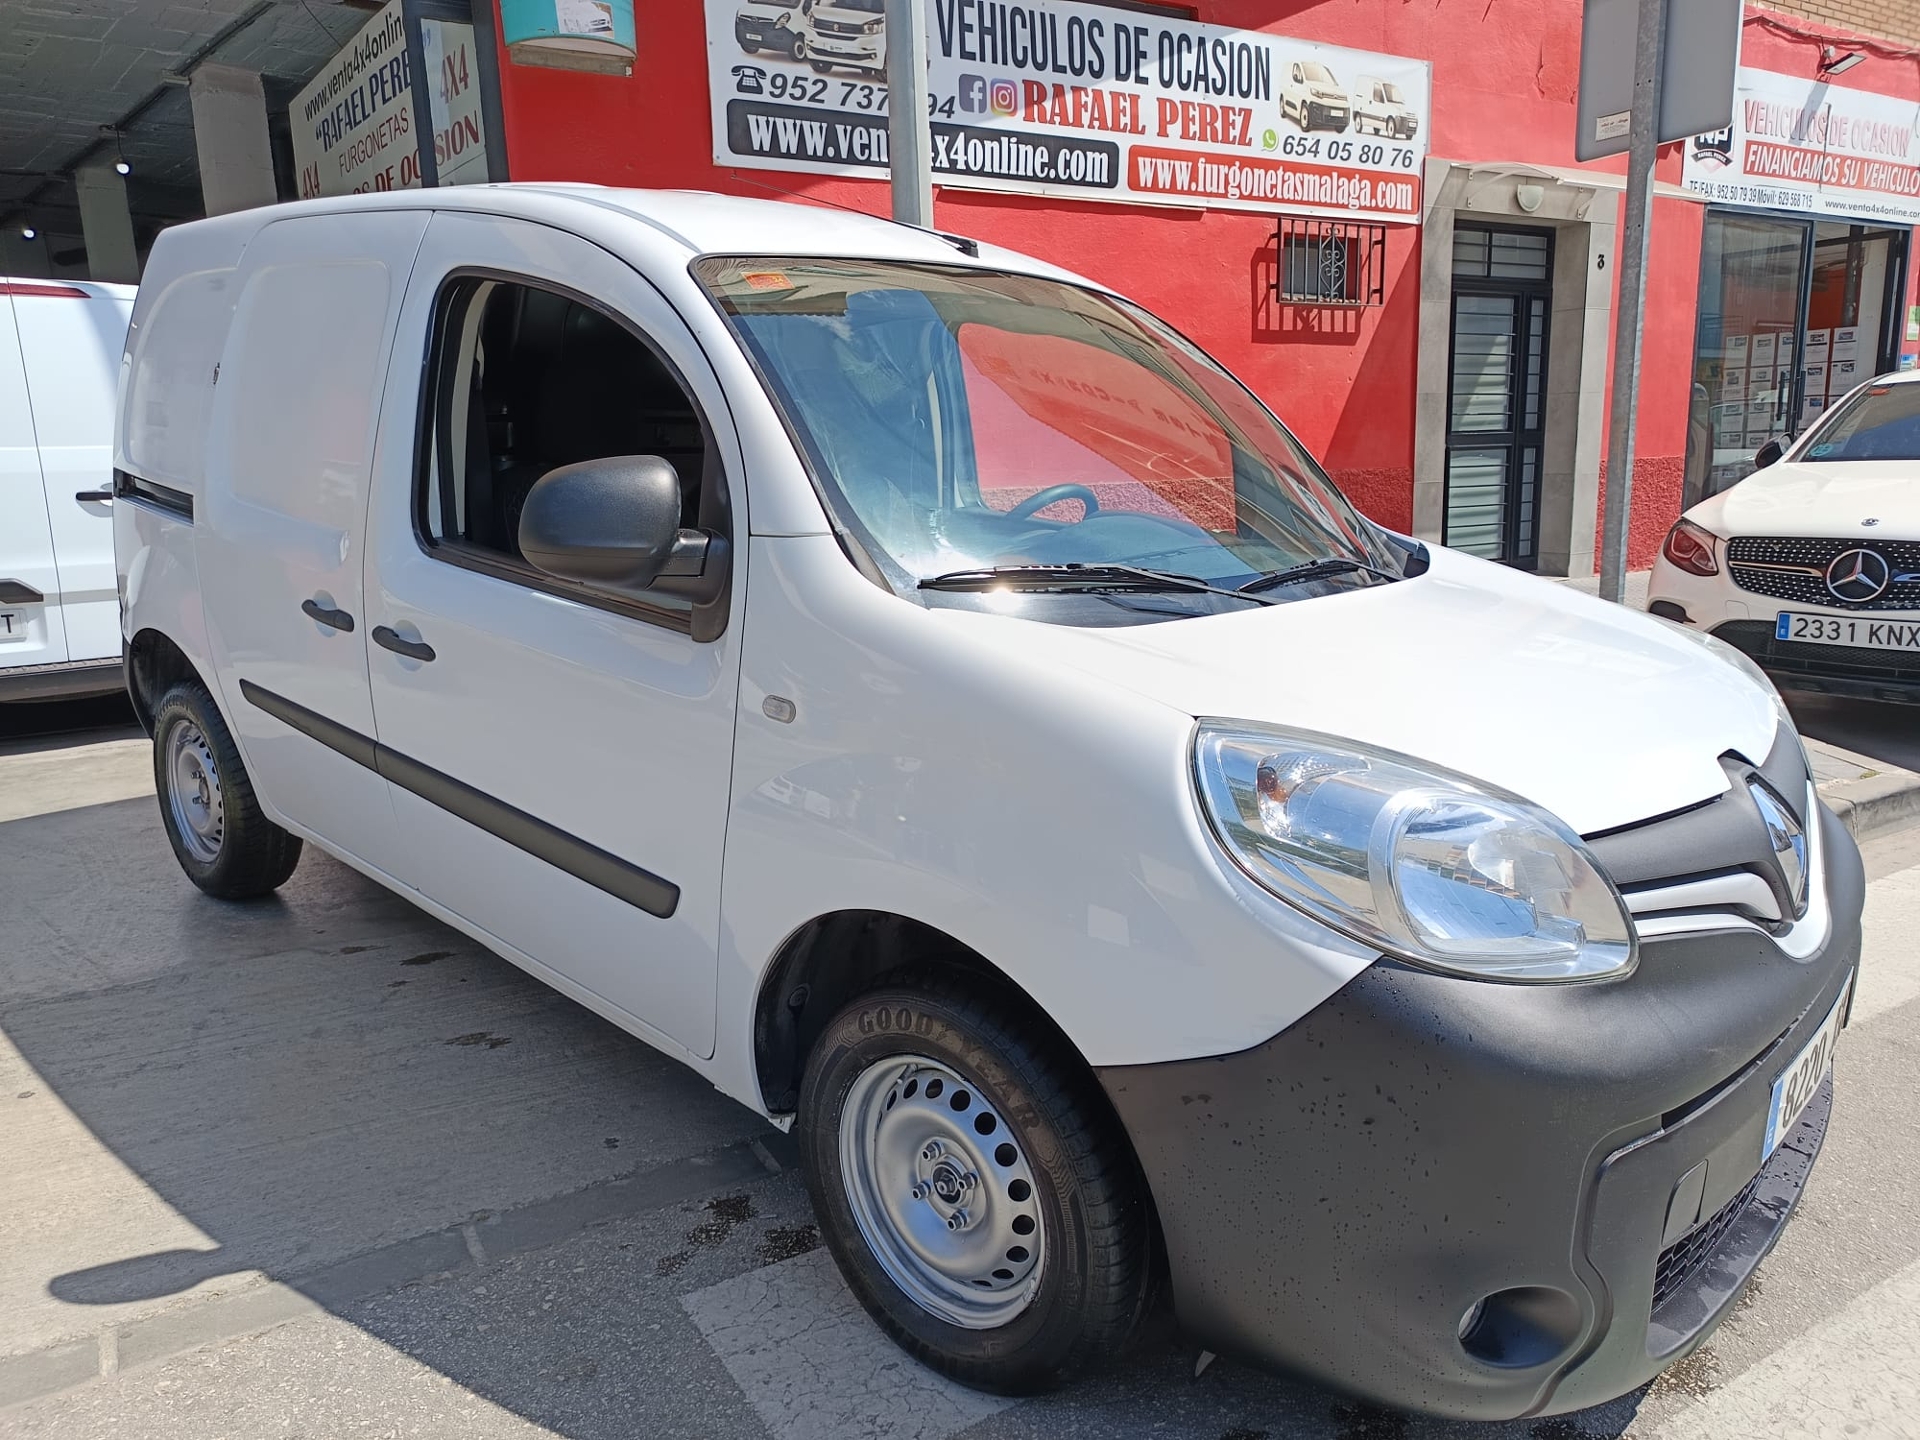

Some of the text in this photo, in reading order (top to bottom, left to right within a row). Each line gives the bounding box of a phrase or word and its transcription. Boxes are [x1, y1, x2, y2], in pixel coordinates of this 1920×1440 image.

[935, 0, 1271, 102] VEHICULOS DE OCASION
[769, 73, 956, 119] 952 737 94
[1022, 79, 1253, 147] RAFAEL PEREZ
[338, 107, 409, 177] FURGONETAS
[1283, 135, 1414, 169] 654 05 80 76
[1744, 98, 1910, 158] VEHICULOS DE OCASION
[1137, 155, 1413, 211] www.furgonetasmalaga.com
[1745, 144, 1920, 195] FINANCIAMOS SU VEHICULO
[1793, 617, 1920, 648] 2331 KNX
[1782, 1030, 1828, 1129] 8220
